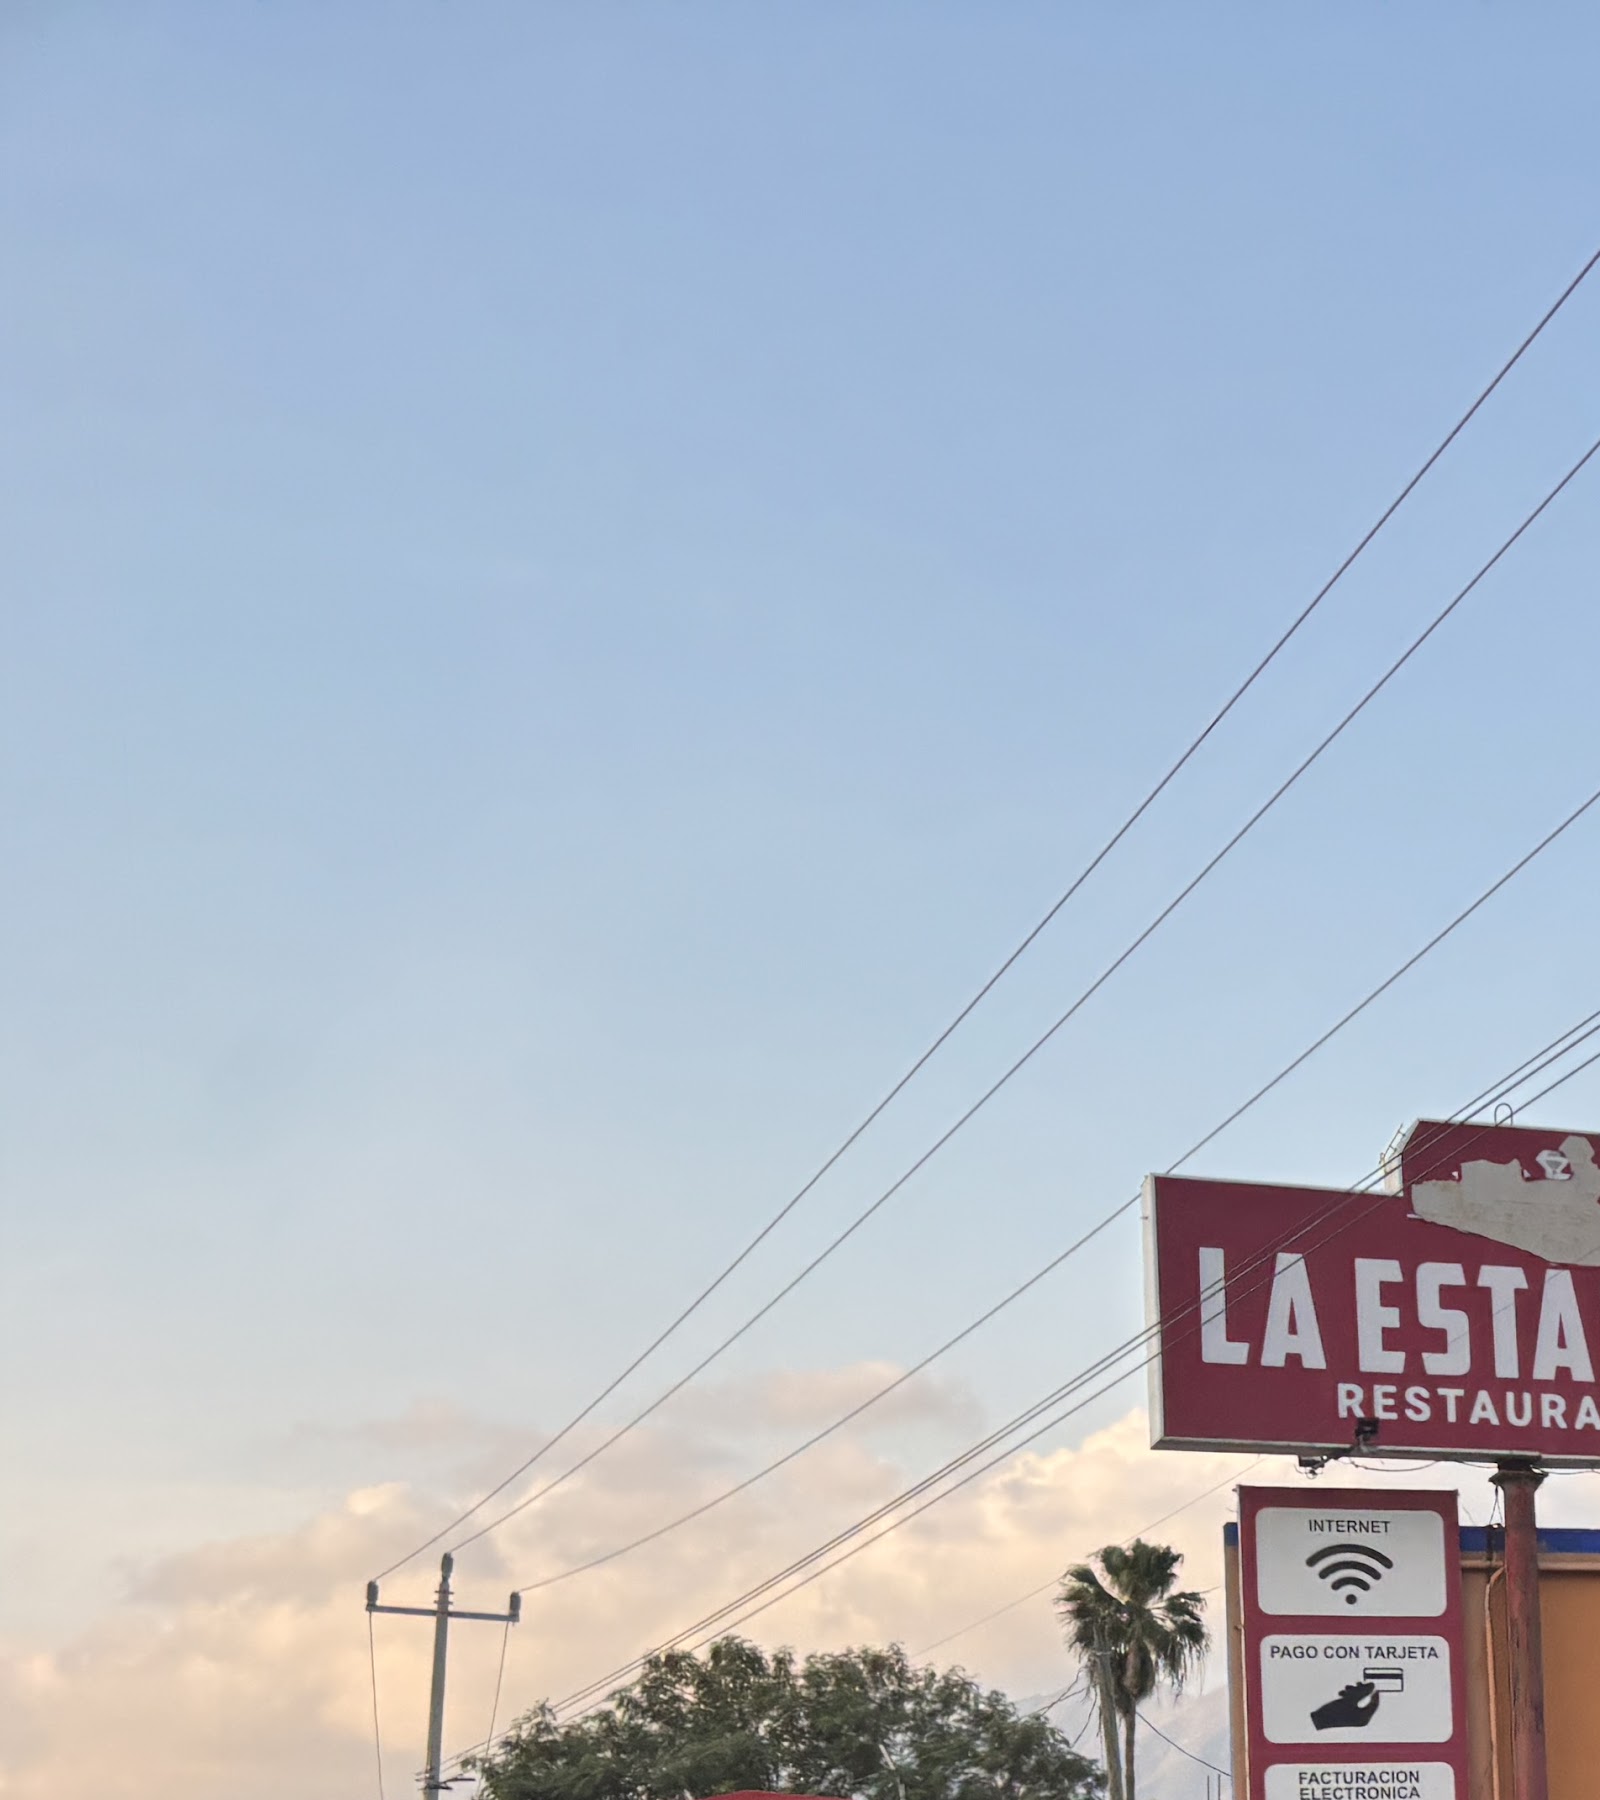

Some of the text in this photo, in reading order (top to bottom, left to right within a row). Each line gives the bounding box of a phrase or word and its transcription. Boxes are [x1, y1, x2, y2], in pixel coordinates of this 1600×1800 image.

[1199, 1247, 1326, 1369] LA
[1308, 1518, 1391, 1534] INTERNET
[1269, 1644, 1440, 1661] PAGO CON TARJETA
[1298, 1770, 1421, 1786] FACTURACION
